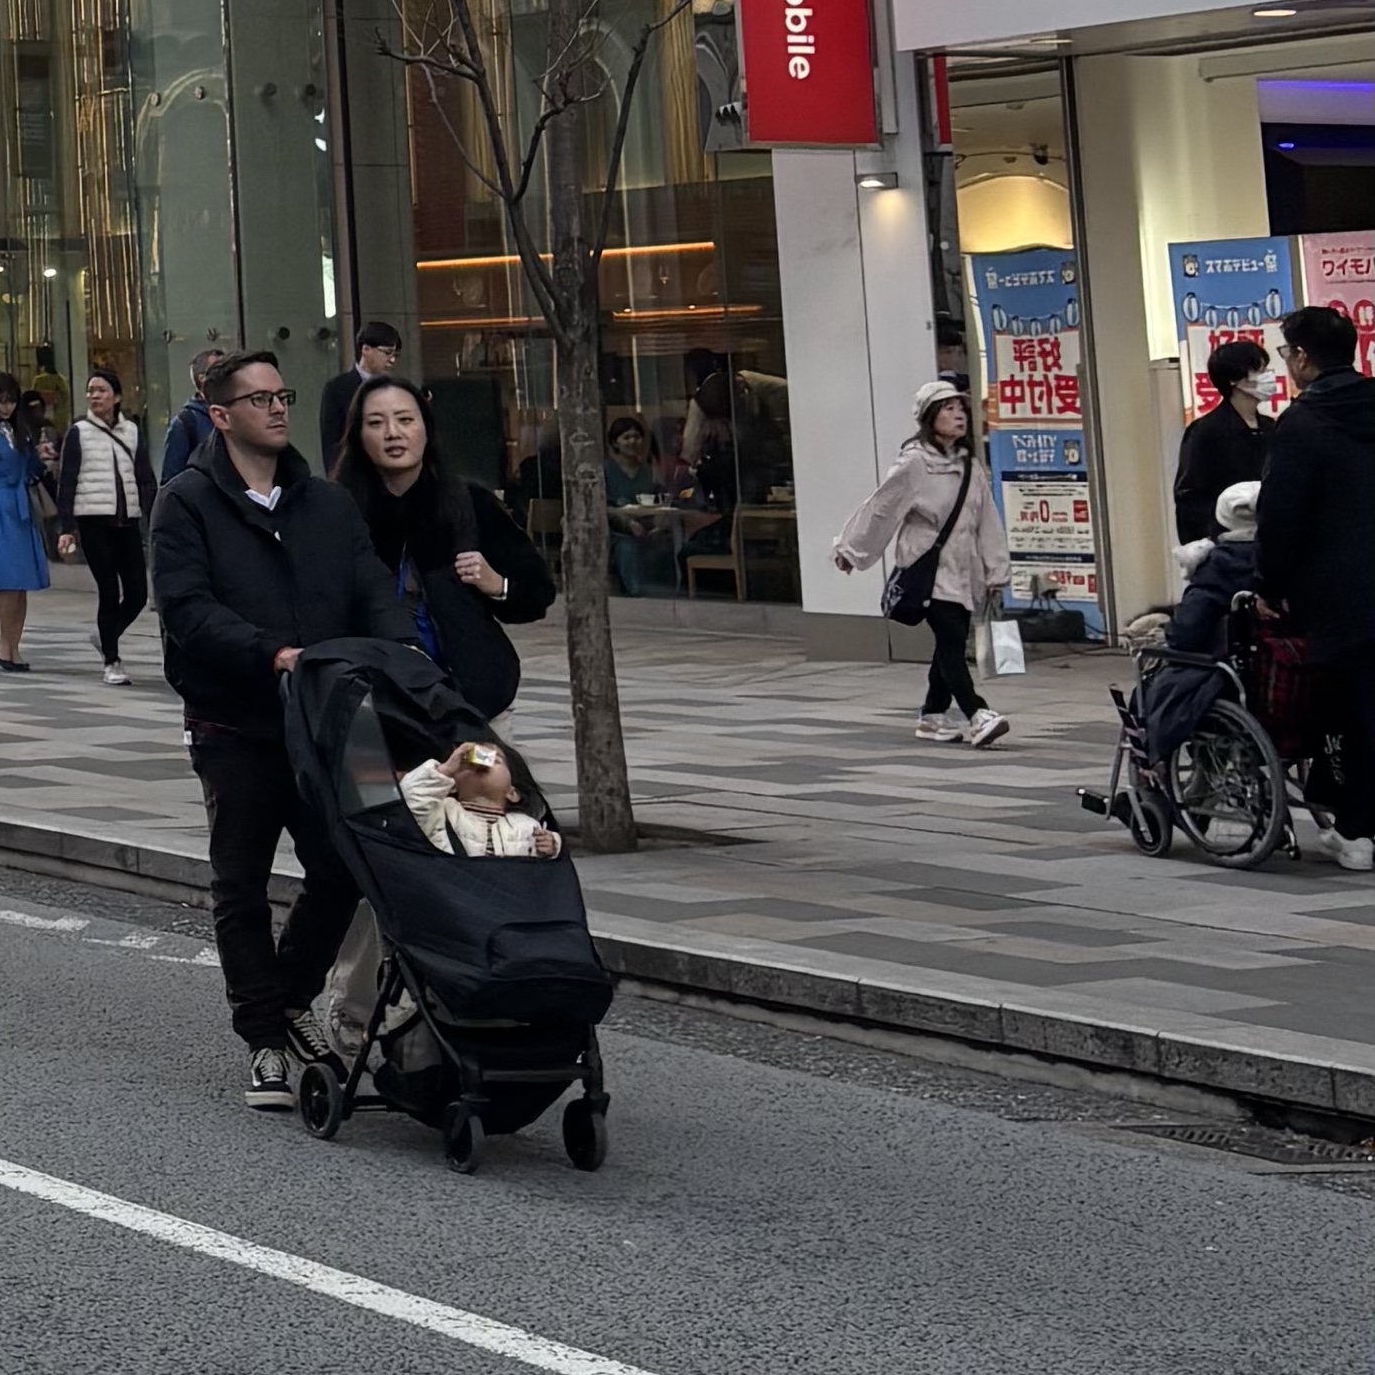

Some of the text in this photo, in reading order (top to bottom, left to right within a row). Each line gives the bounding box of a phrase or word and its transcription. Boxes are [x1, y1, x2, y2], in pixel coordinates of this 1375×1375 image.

[1204, 250, 1278, 274] スマホデビュー祭
